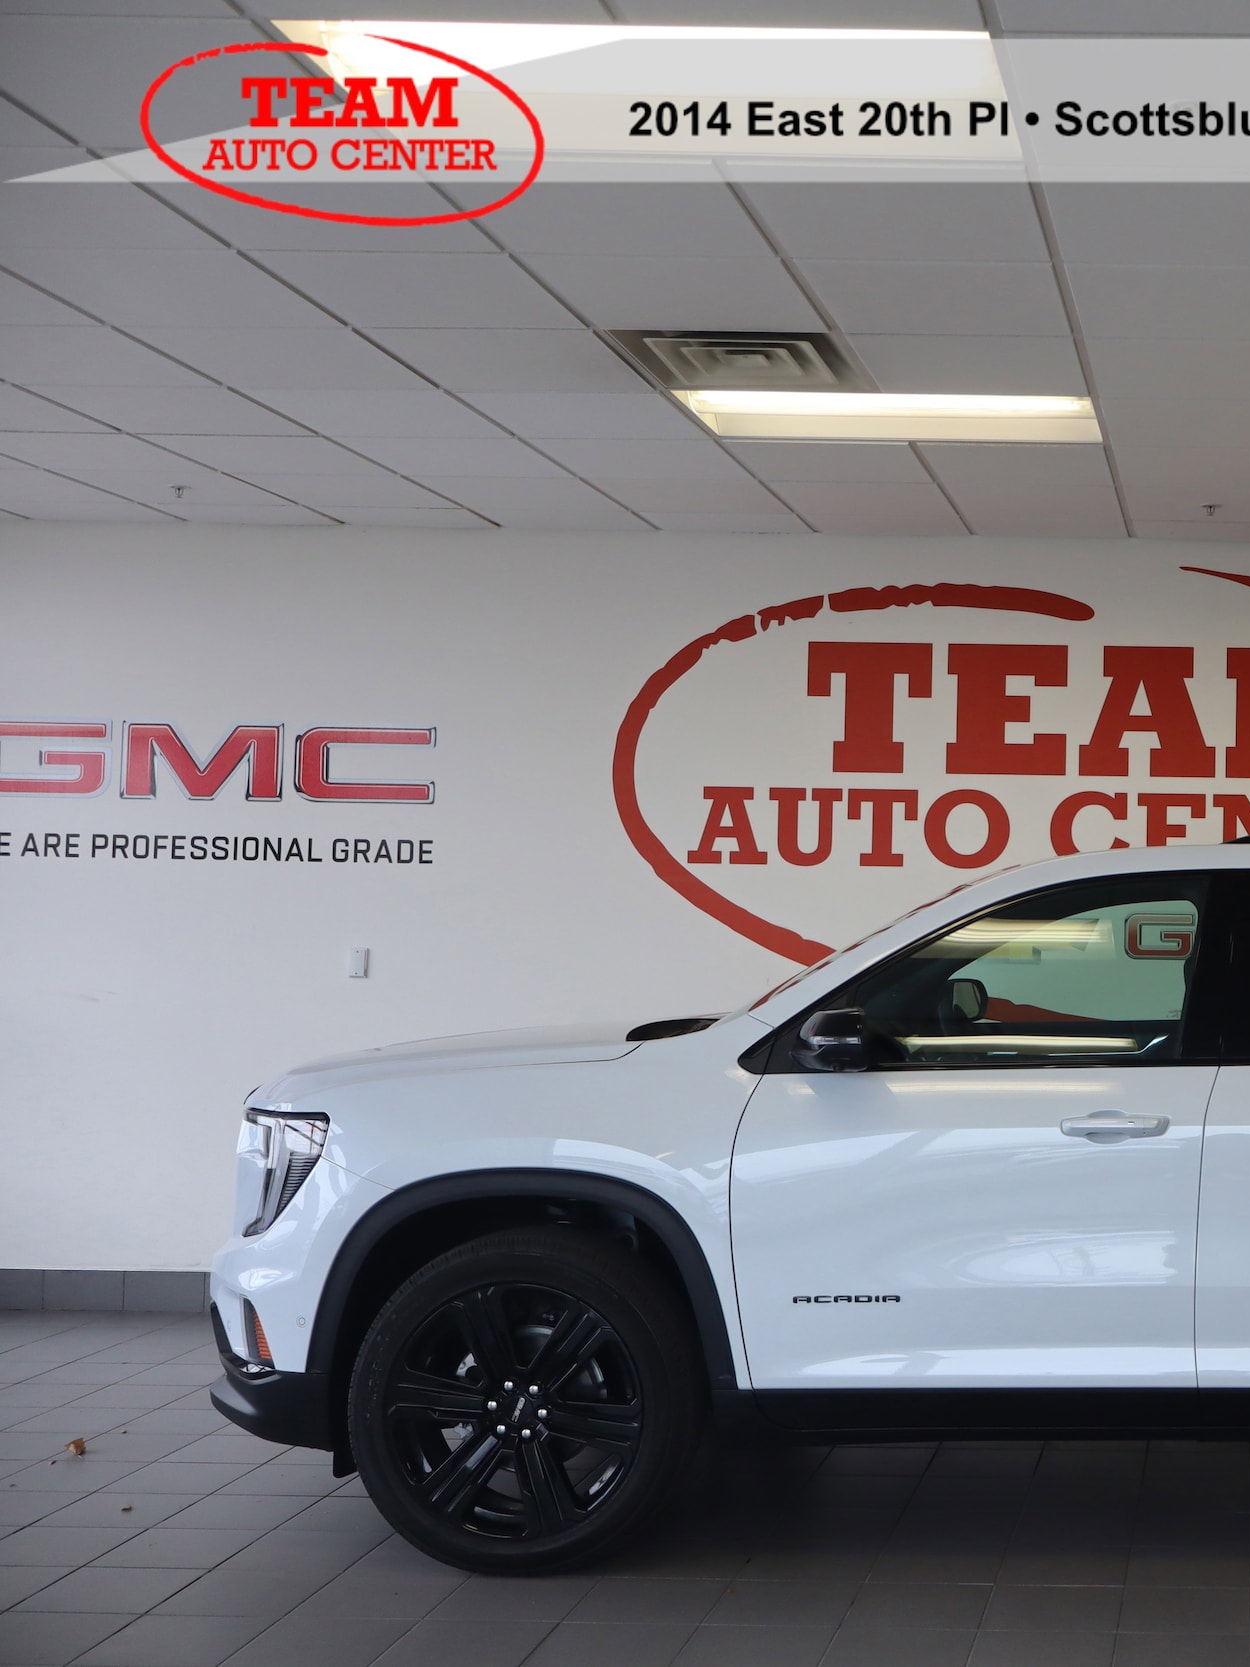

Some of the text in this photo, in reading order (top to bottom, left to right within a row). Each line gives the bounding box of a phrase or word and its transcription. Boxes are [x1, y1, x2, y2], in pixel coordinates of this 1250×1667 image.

[0, 719, 436, 804] GMC
[20, 832, 80, 858] ARE
[91, 834, 323, 863] PROFESSIONAL
[332, 838, 434, 864] GRADE
[686, 786, 1010, 868] AUTO
[792, 1294, 901, 1304] ACADIA
